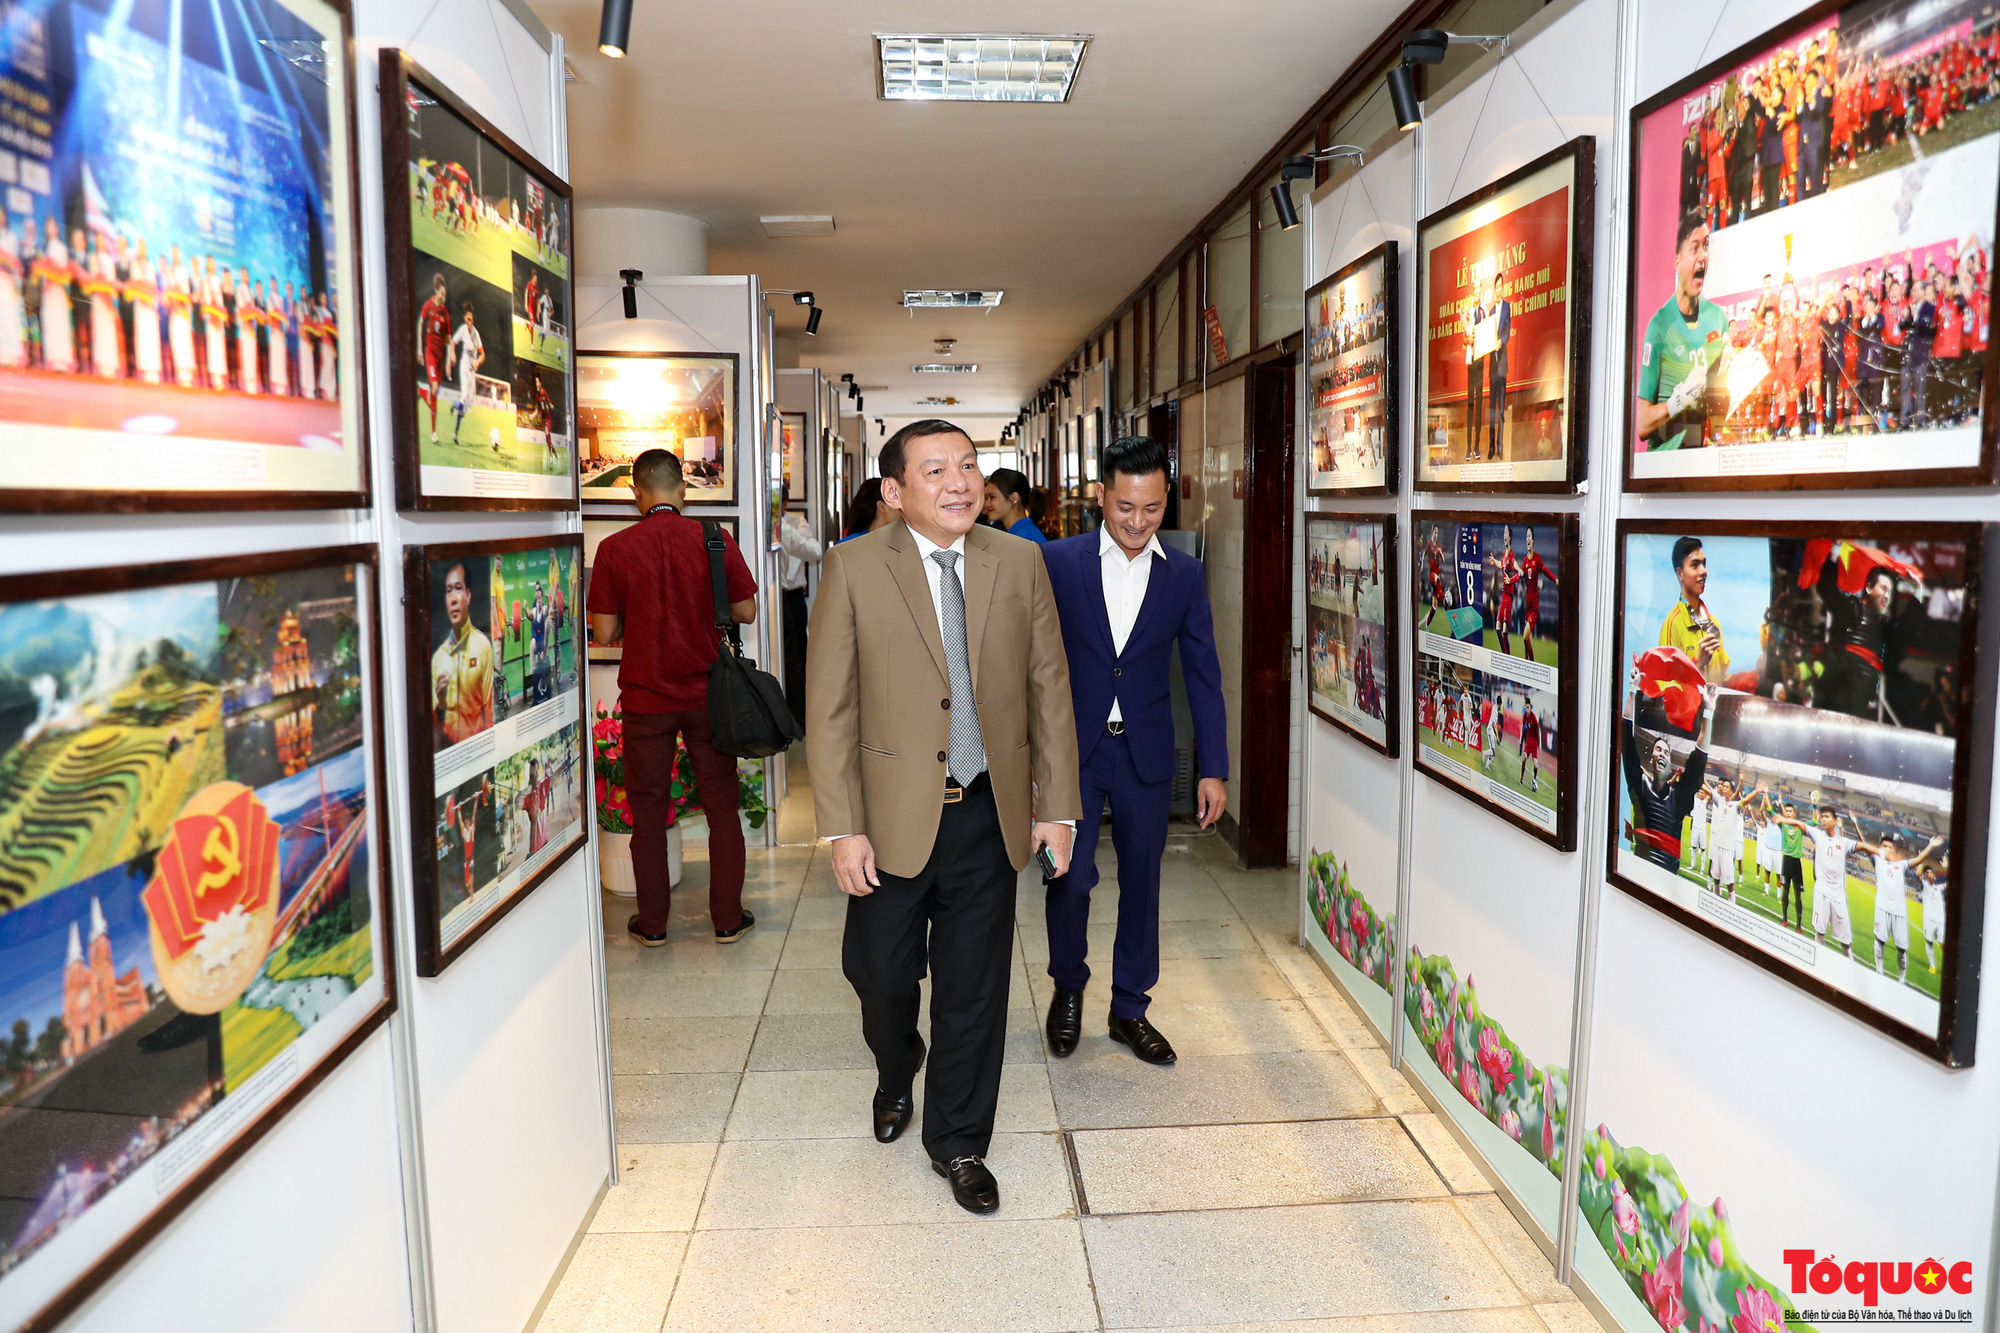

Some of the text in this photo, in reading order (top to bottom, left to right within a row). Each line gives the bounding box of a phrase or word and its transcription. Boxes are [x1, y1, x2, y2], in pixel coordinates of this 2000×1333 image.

[1456, 257, 1468, 289] LỄ
[1498, 242, 1526, 276] TẶNG
[1514, 273, 1535, 295] HẠNG
[1525, 291, 1547, 314] CHÍNH
[650, 505, 673, 514] Canon
[1466, 570, 1475, 606] 8
